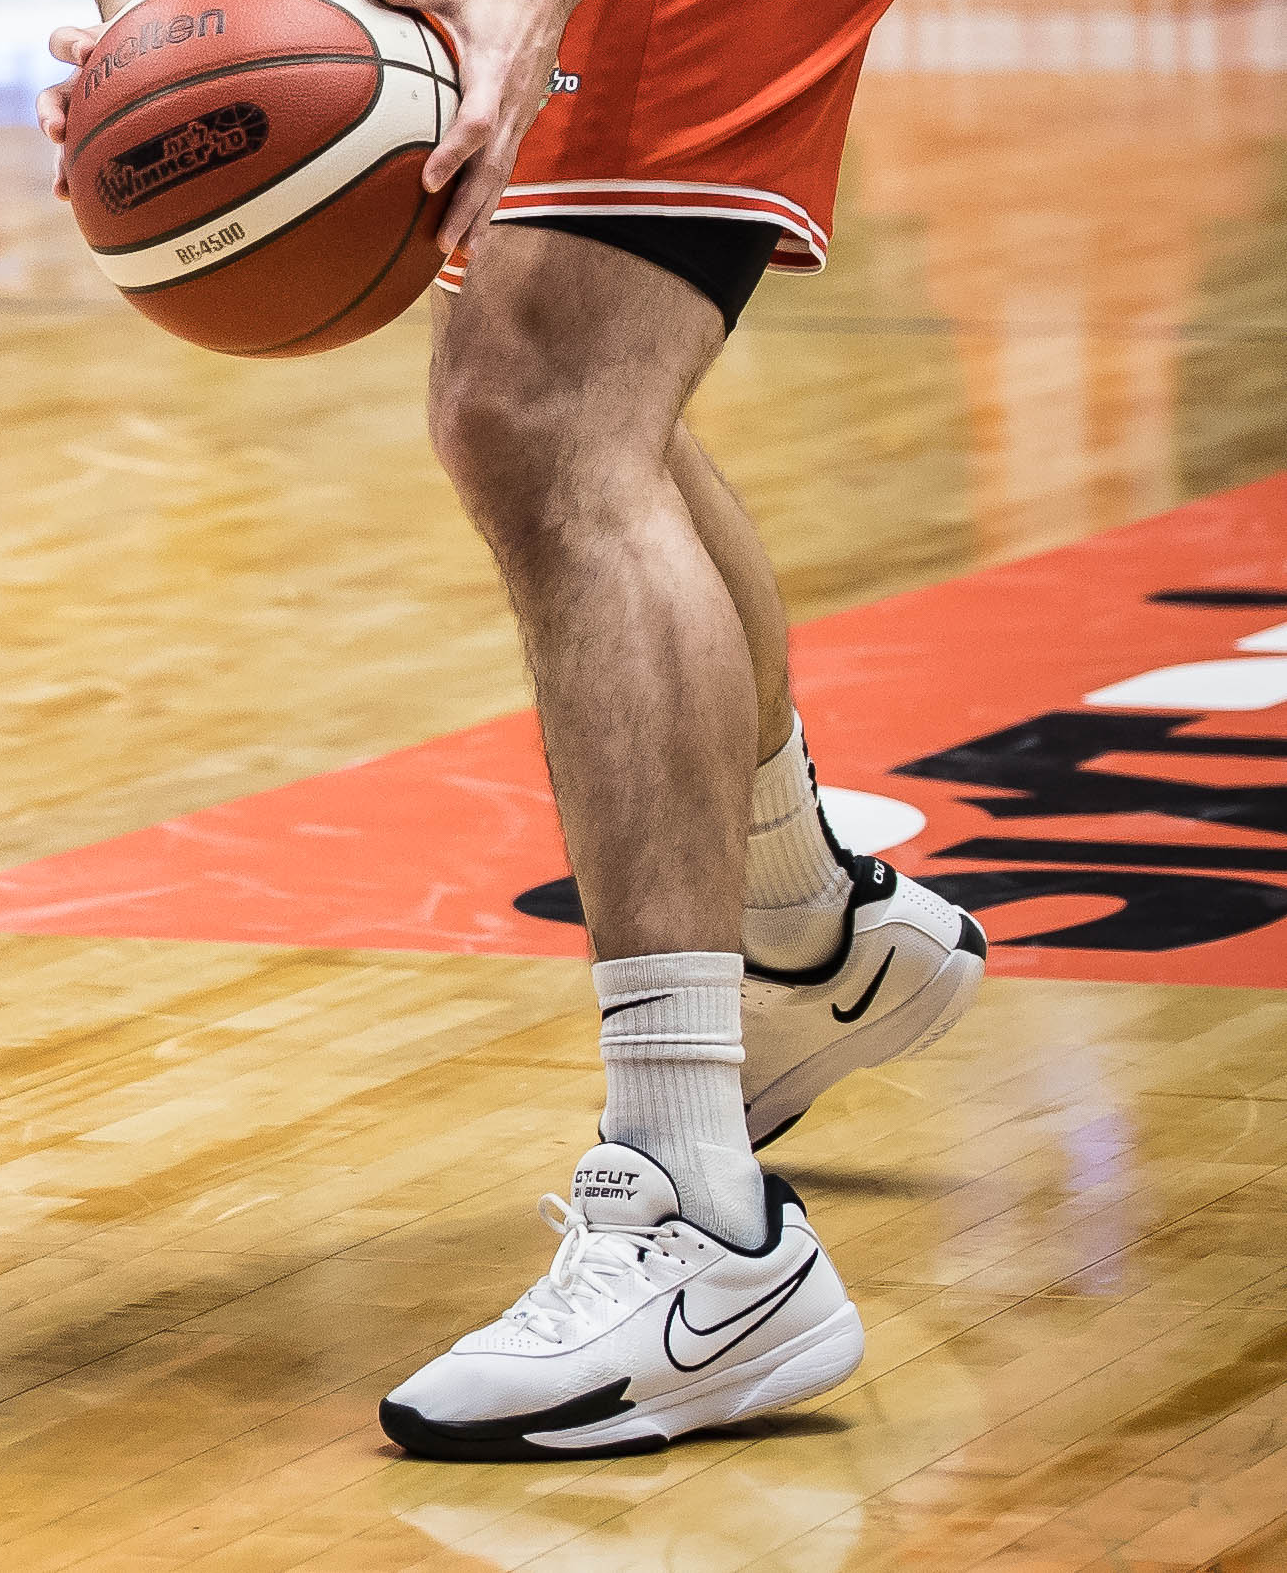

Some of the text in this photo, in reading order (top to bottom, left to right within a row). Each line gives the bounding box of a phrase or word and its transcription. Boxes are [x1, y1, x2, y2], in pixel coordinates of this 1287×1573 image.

[84, 8, 225, 100] molten
[174, 221, 246, 265] BG4500
[595, 1170, 640, 1186] CUT
